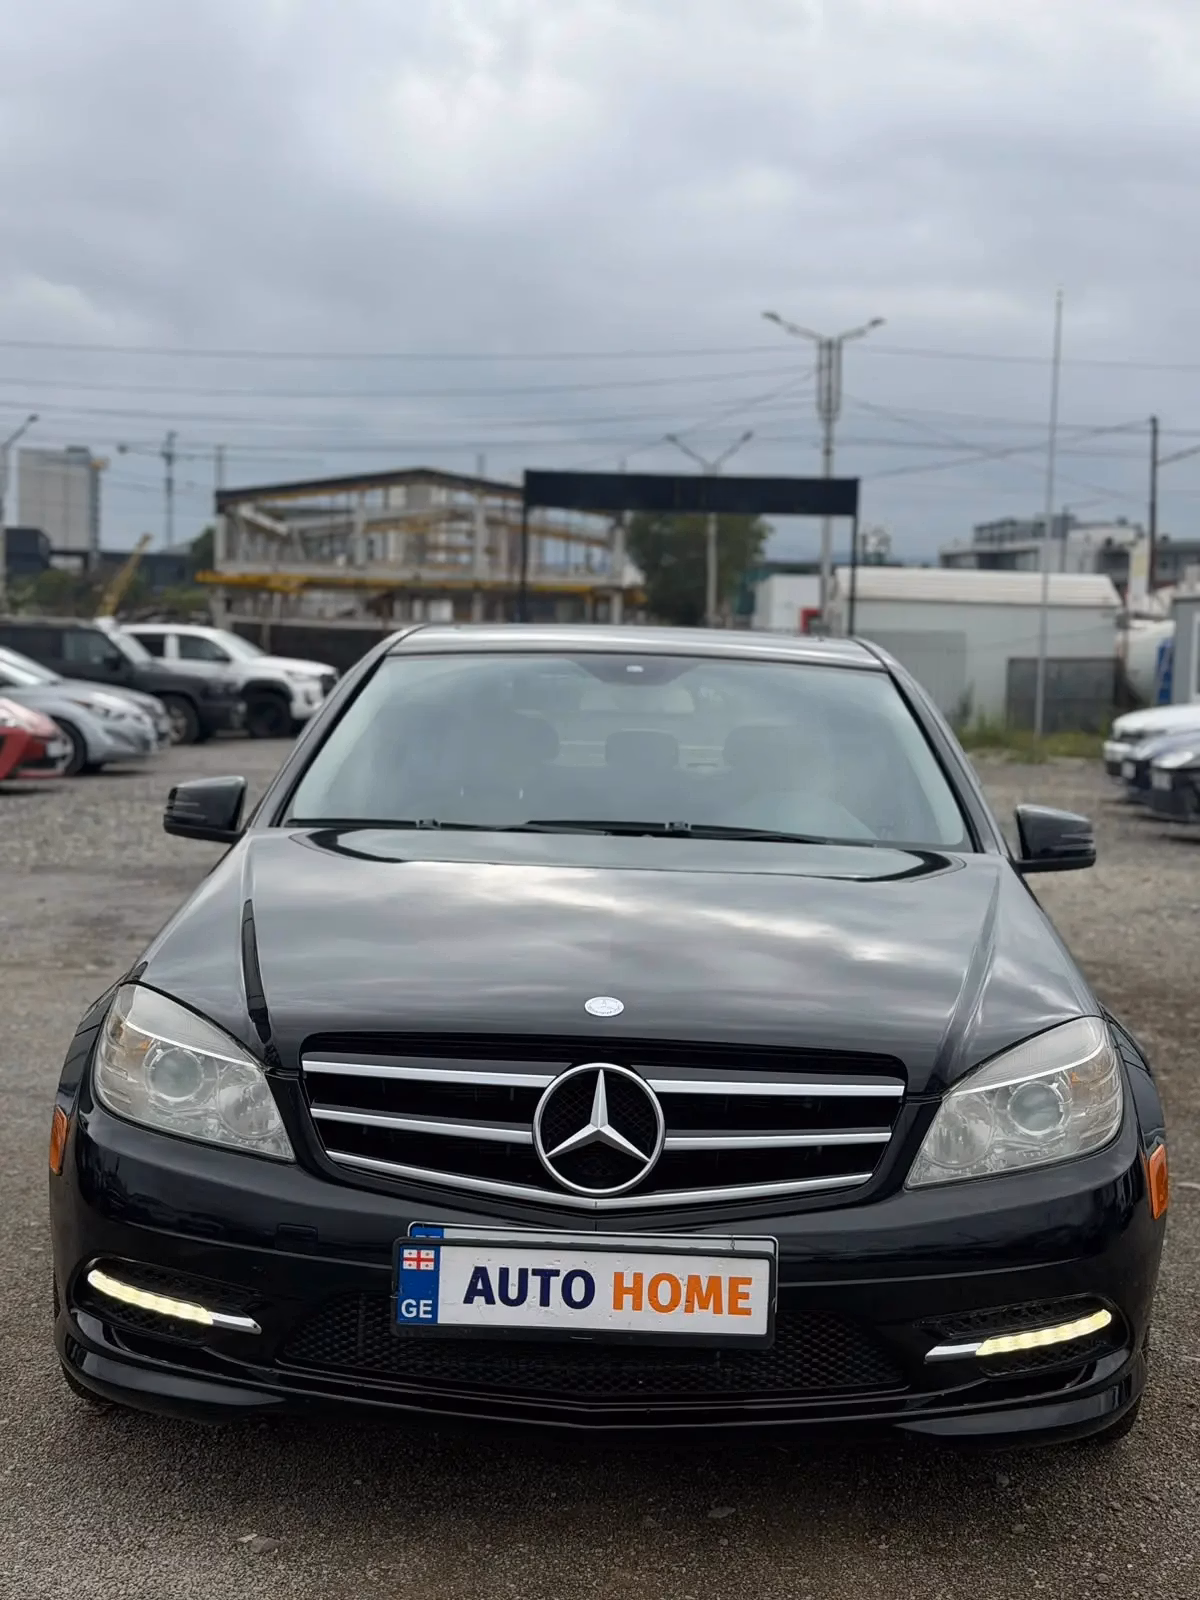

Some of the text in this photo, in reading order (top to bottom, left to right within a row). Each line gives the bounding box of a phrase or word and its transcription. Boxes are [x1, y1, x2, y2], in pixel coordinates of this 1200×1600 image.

[463, 1266, 753, 1316] AUTO HOME
[401, 1299, 433, 1319] GE
